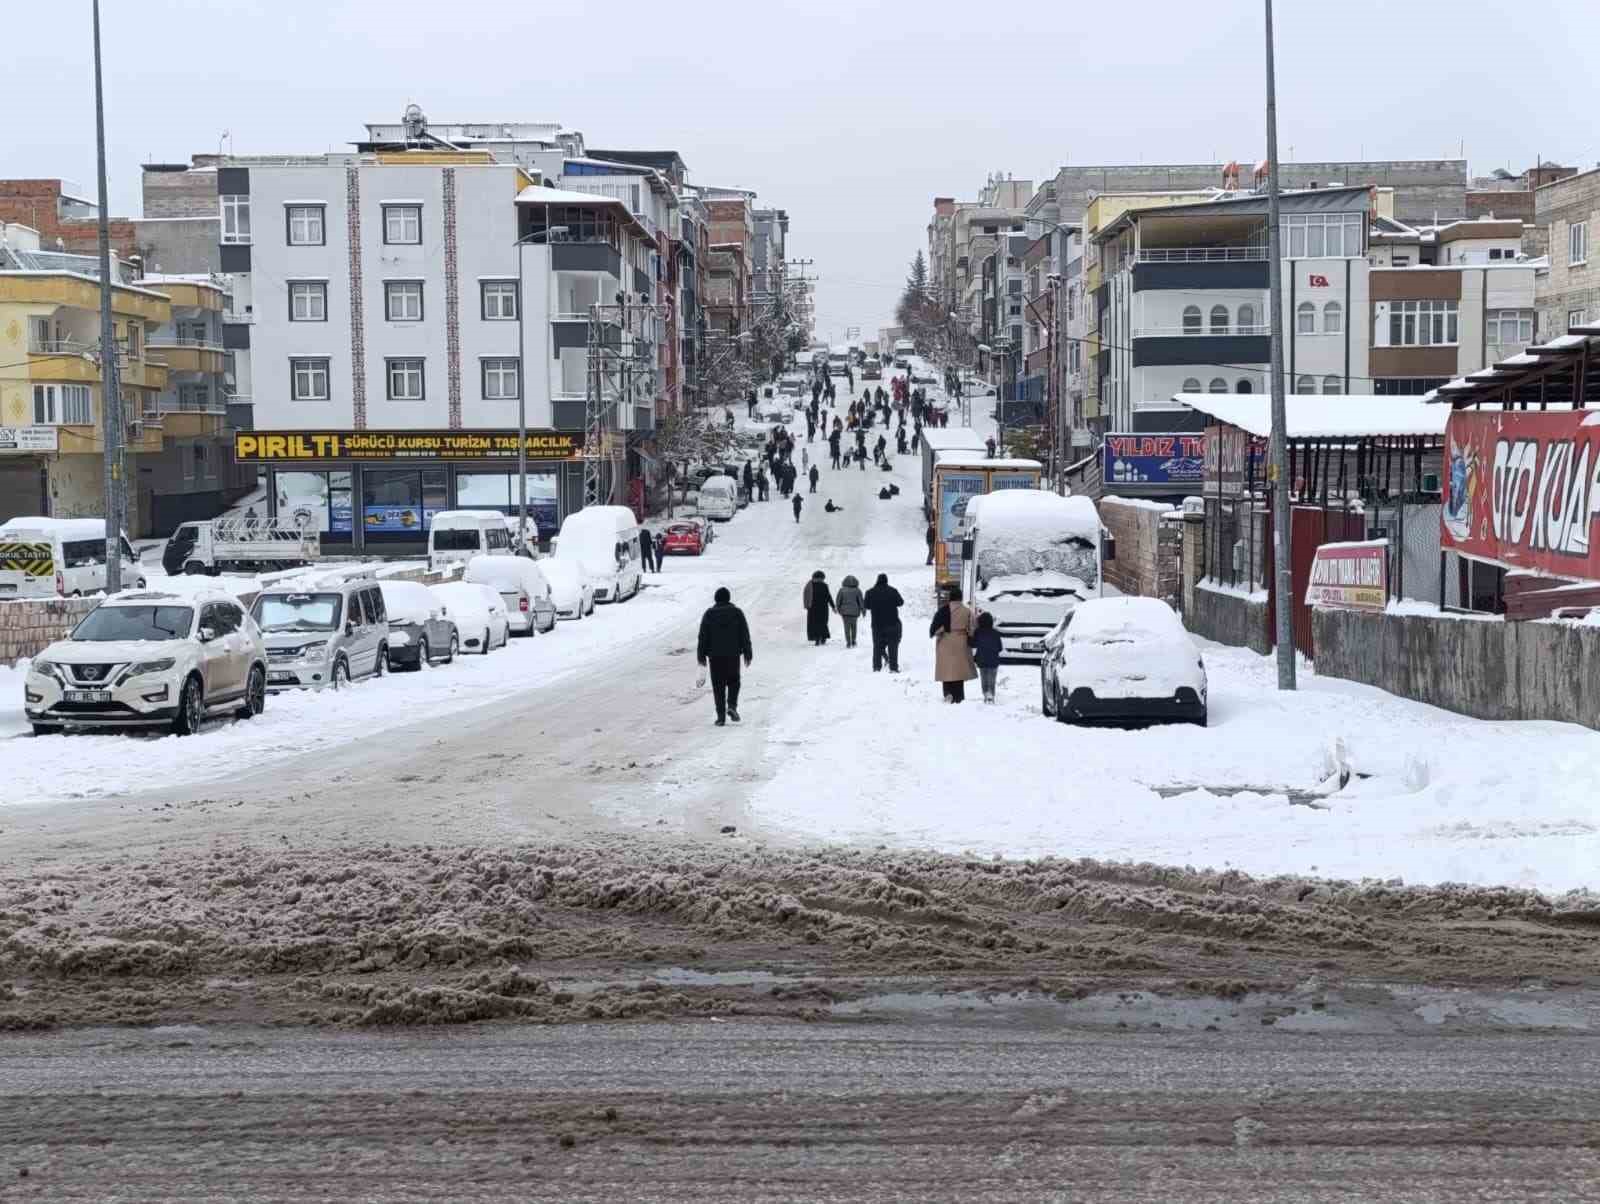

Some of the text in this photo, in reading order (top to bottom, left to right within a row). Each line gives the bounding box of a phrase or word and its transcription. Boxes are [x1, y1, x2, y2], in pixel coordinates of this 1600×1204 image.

[237, 435, 339, 457] PIRILTI
[344, 435, 395, 449] SÜRÜCÜ
[398, 438, 441, 449] KURSU
[444, 435, 491, 449] TURİZM
[494, 437, 572, 449] TAŞIMACILIK
[1108, 437, 1175, 457] YILDIZ
[1492, 440, 1539, 544] OTO
[24, 551, 50, 560] TAŞITI
